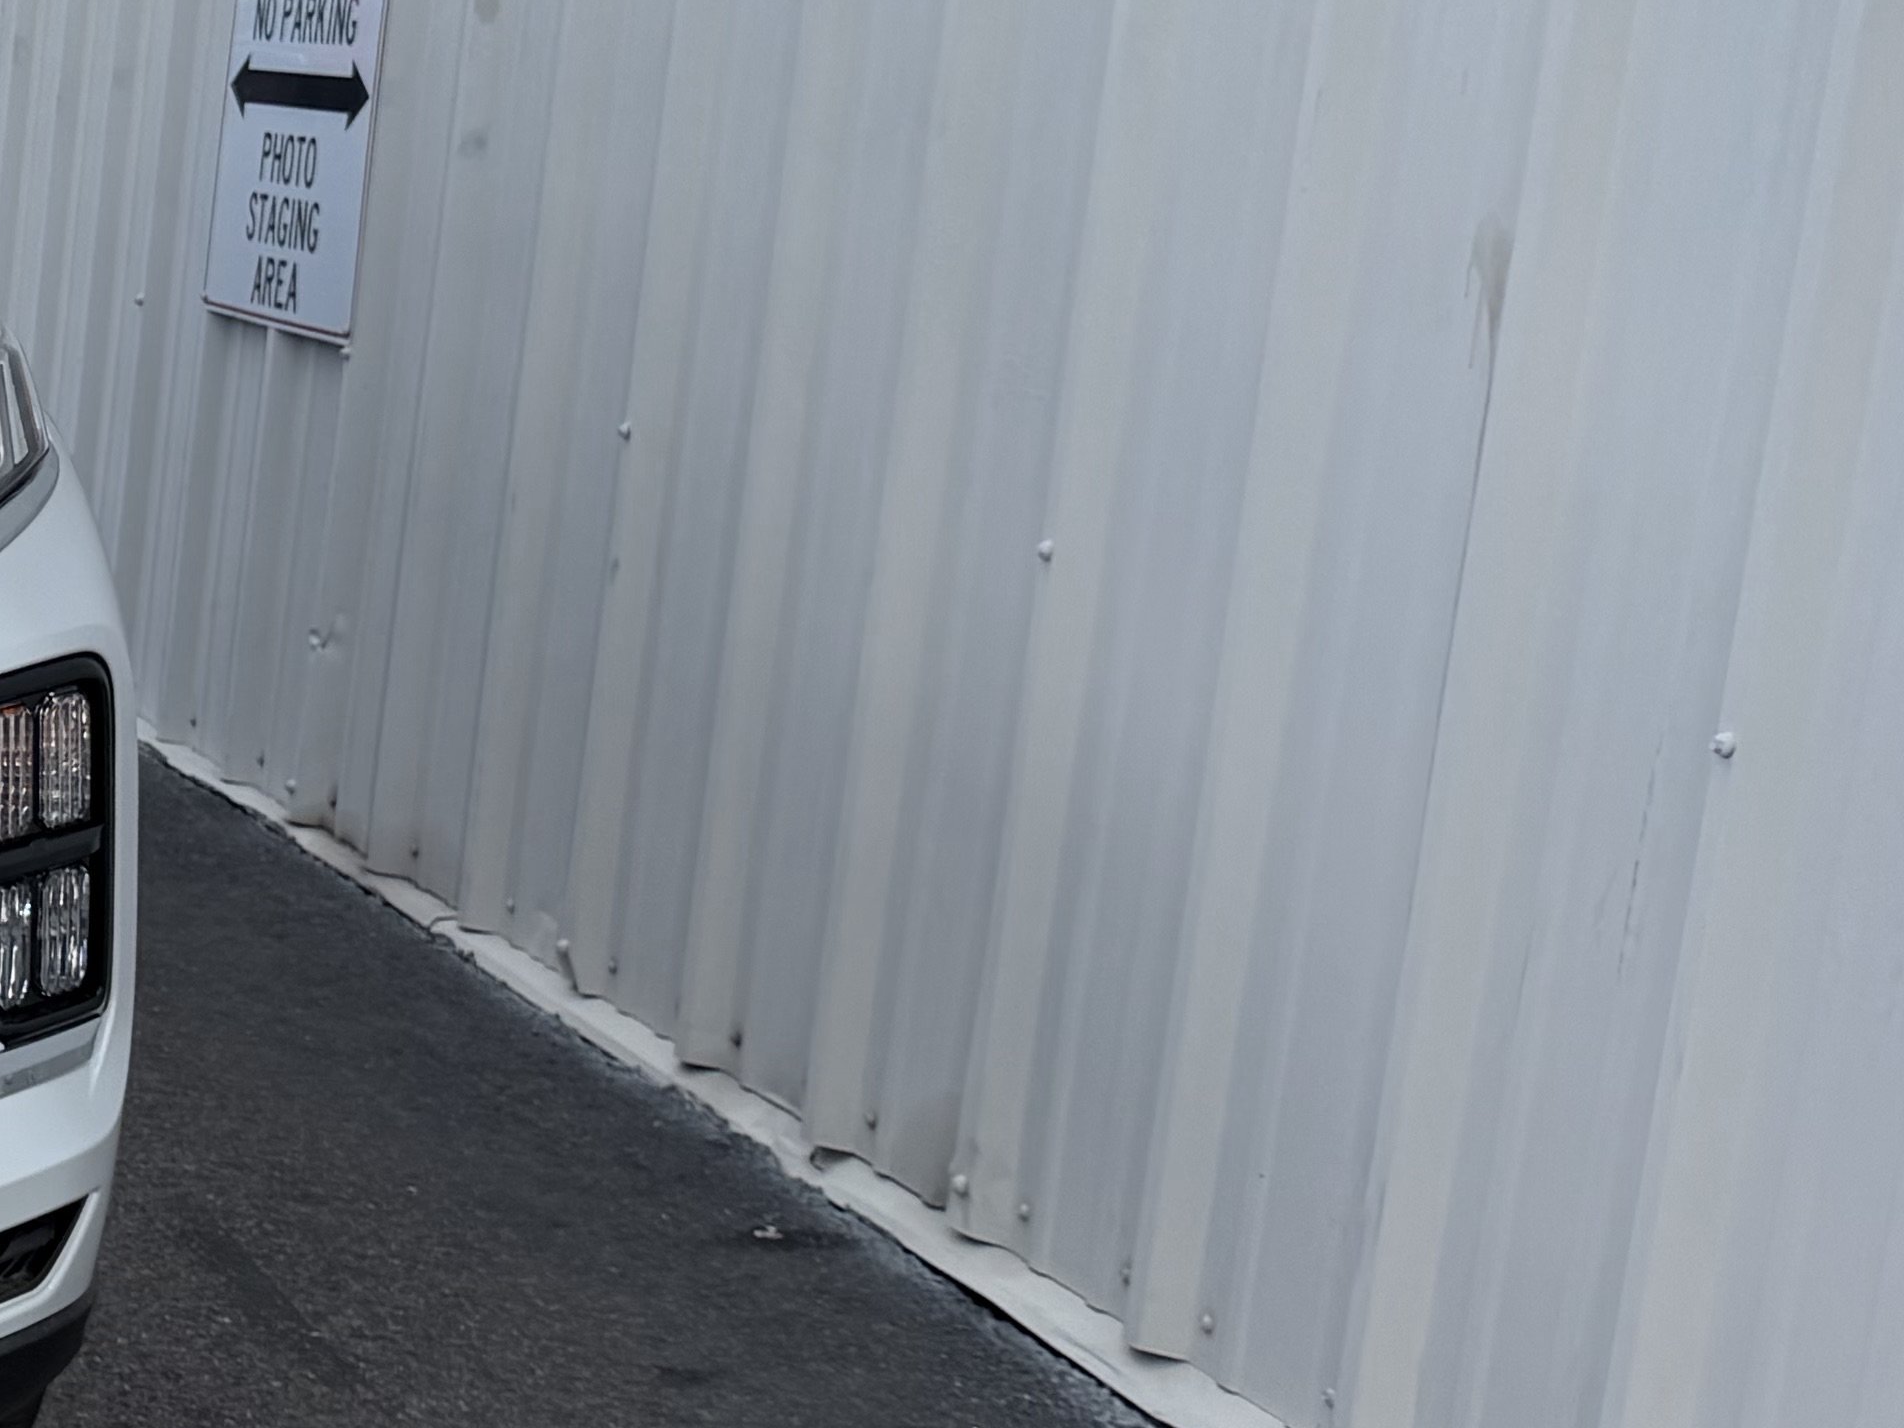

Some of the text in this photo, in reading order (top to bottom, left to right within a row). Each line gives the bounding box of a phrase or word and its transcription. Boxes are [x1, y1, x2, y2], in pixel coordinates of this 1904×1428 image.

[259, 131, 318, 190] PHOTO
[246, 191, 321, 254] STAGING
[250, 254, 298, 315] AREA
